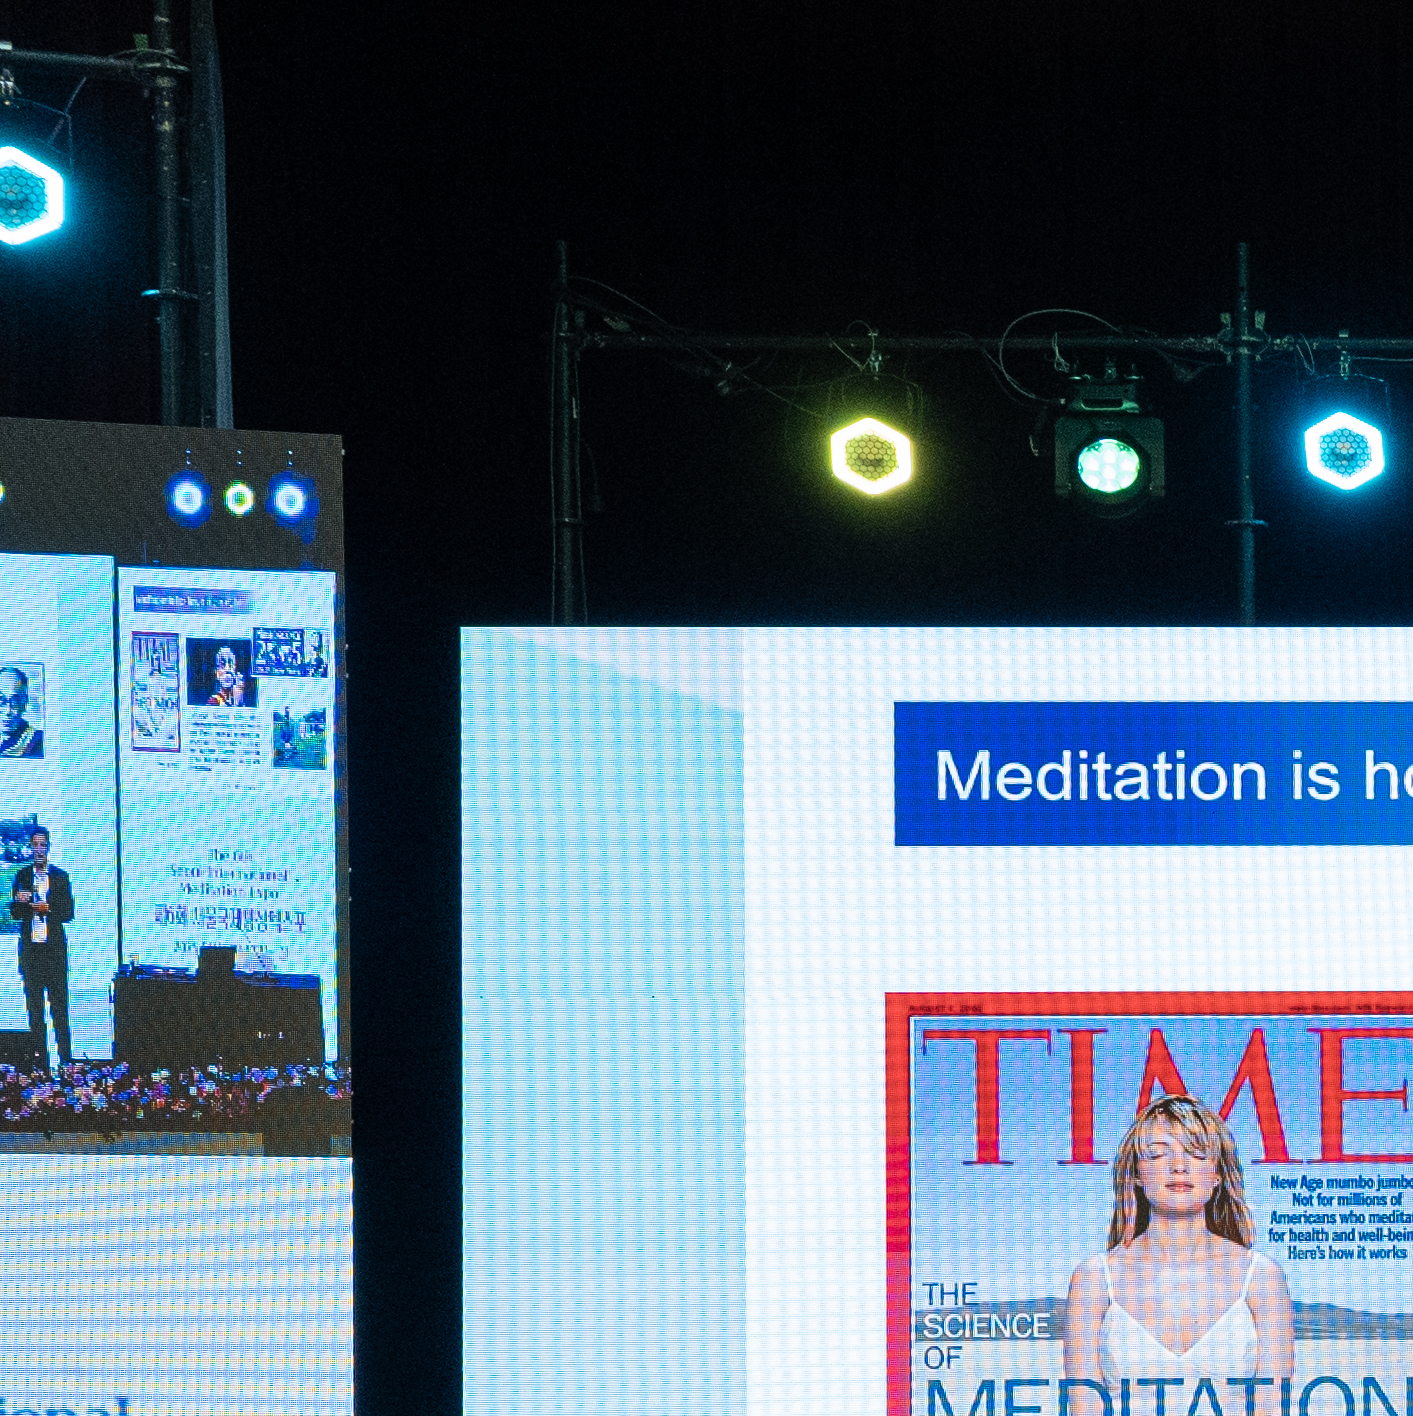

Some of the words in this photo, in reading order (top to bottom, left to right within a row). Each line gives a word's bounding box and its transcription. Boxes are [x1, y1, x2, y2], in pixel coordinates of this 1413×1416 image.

[937, 749, 1266, 802] Meditation
[1293, 749, 1340, 802] is
[1271, 1174, 1298, 1189] New
[1300, 1174, 1323, 1191] Age
[1326, 1174, 1375, 1189] mumbo
[1292, 1192, 1314, 1206] Not
[1317, 1192, 1336, 1206] for
[1337, 1192, 1387, 1206] millions
[1390, 1192, 1403, 1206] of
[1270, 1210, 1337, 1224] Americans
[1339, 1210, 1365, 1224] who
[1268, 1228, 1287, 1242] for
[1288, 1227, 1329, 1242] health
[1331, 1227, 1356, 1242] and
[1328, 1245, 1355, 1260] how
[1356, 1244, 1367, 1260] it
[1368, 1245, 1408, 1260] works
[922, 1281, 979, 1306] THE
[922, 1311, 1052, 1341] SCIENCE
[923, 1345, 963, 1370] OF
